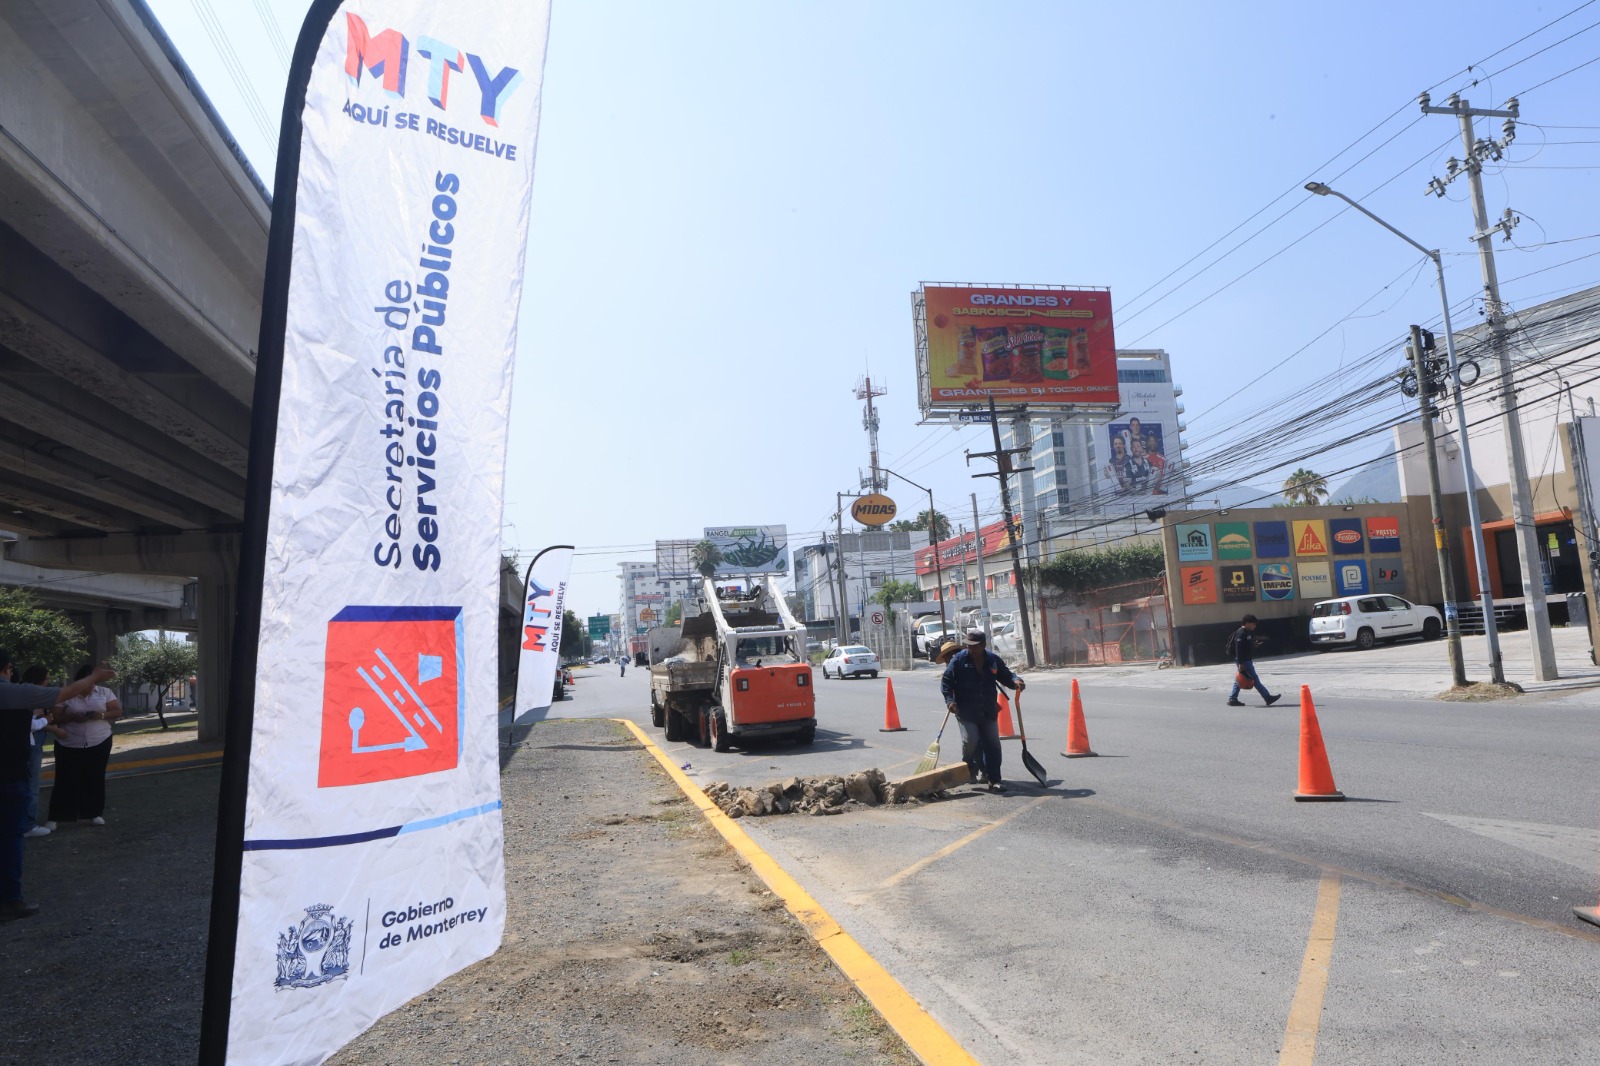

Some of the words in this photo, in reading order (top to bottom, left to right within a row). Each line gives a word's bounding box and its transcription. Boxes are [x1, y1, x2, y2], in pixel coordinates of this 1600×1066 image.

[345, 12, 525, 128] MTY
[342, 98, 390, 128] AQUÍ
[395, 112, 420, 132] SE
[426, 117, 517, 161] RESUELVE
[412, 170, 460, 356] Públicos
[374, 279, 412, 330] de
[952, 307, 1094, 318] SABROSONES
[969, 293, 1058, 307] GRANDES
[1062, 297, 1072, 306] Y
[939, 387, 1027, 397] GRANDES
[1031, 387, 1046, 395] EN
[371, 345, 407, 570] Secretaría
[406, 366, 441, 573] Servicios
[855, 499, 896, 515] MIDAS
[1301, 533, 1322, 551] Sika
[1375, 528, 1397, 537] PRESTO
[1263, 580, 1292, 589] IMPAC
[522, 577, 554, 652] MTY
[555, 581, 567, 620] RESUELVE
[554, 620, 561, 632] SE
[551, 632, 560, 653] AQUÍ
[381, 897, 454, 928] Gobierno
[379, 932, 401, 950] de
[406, 907, 488, 943] Monterrey
